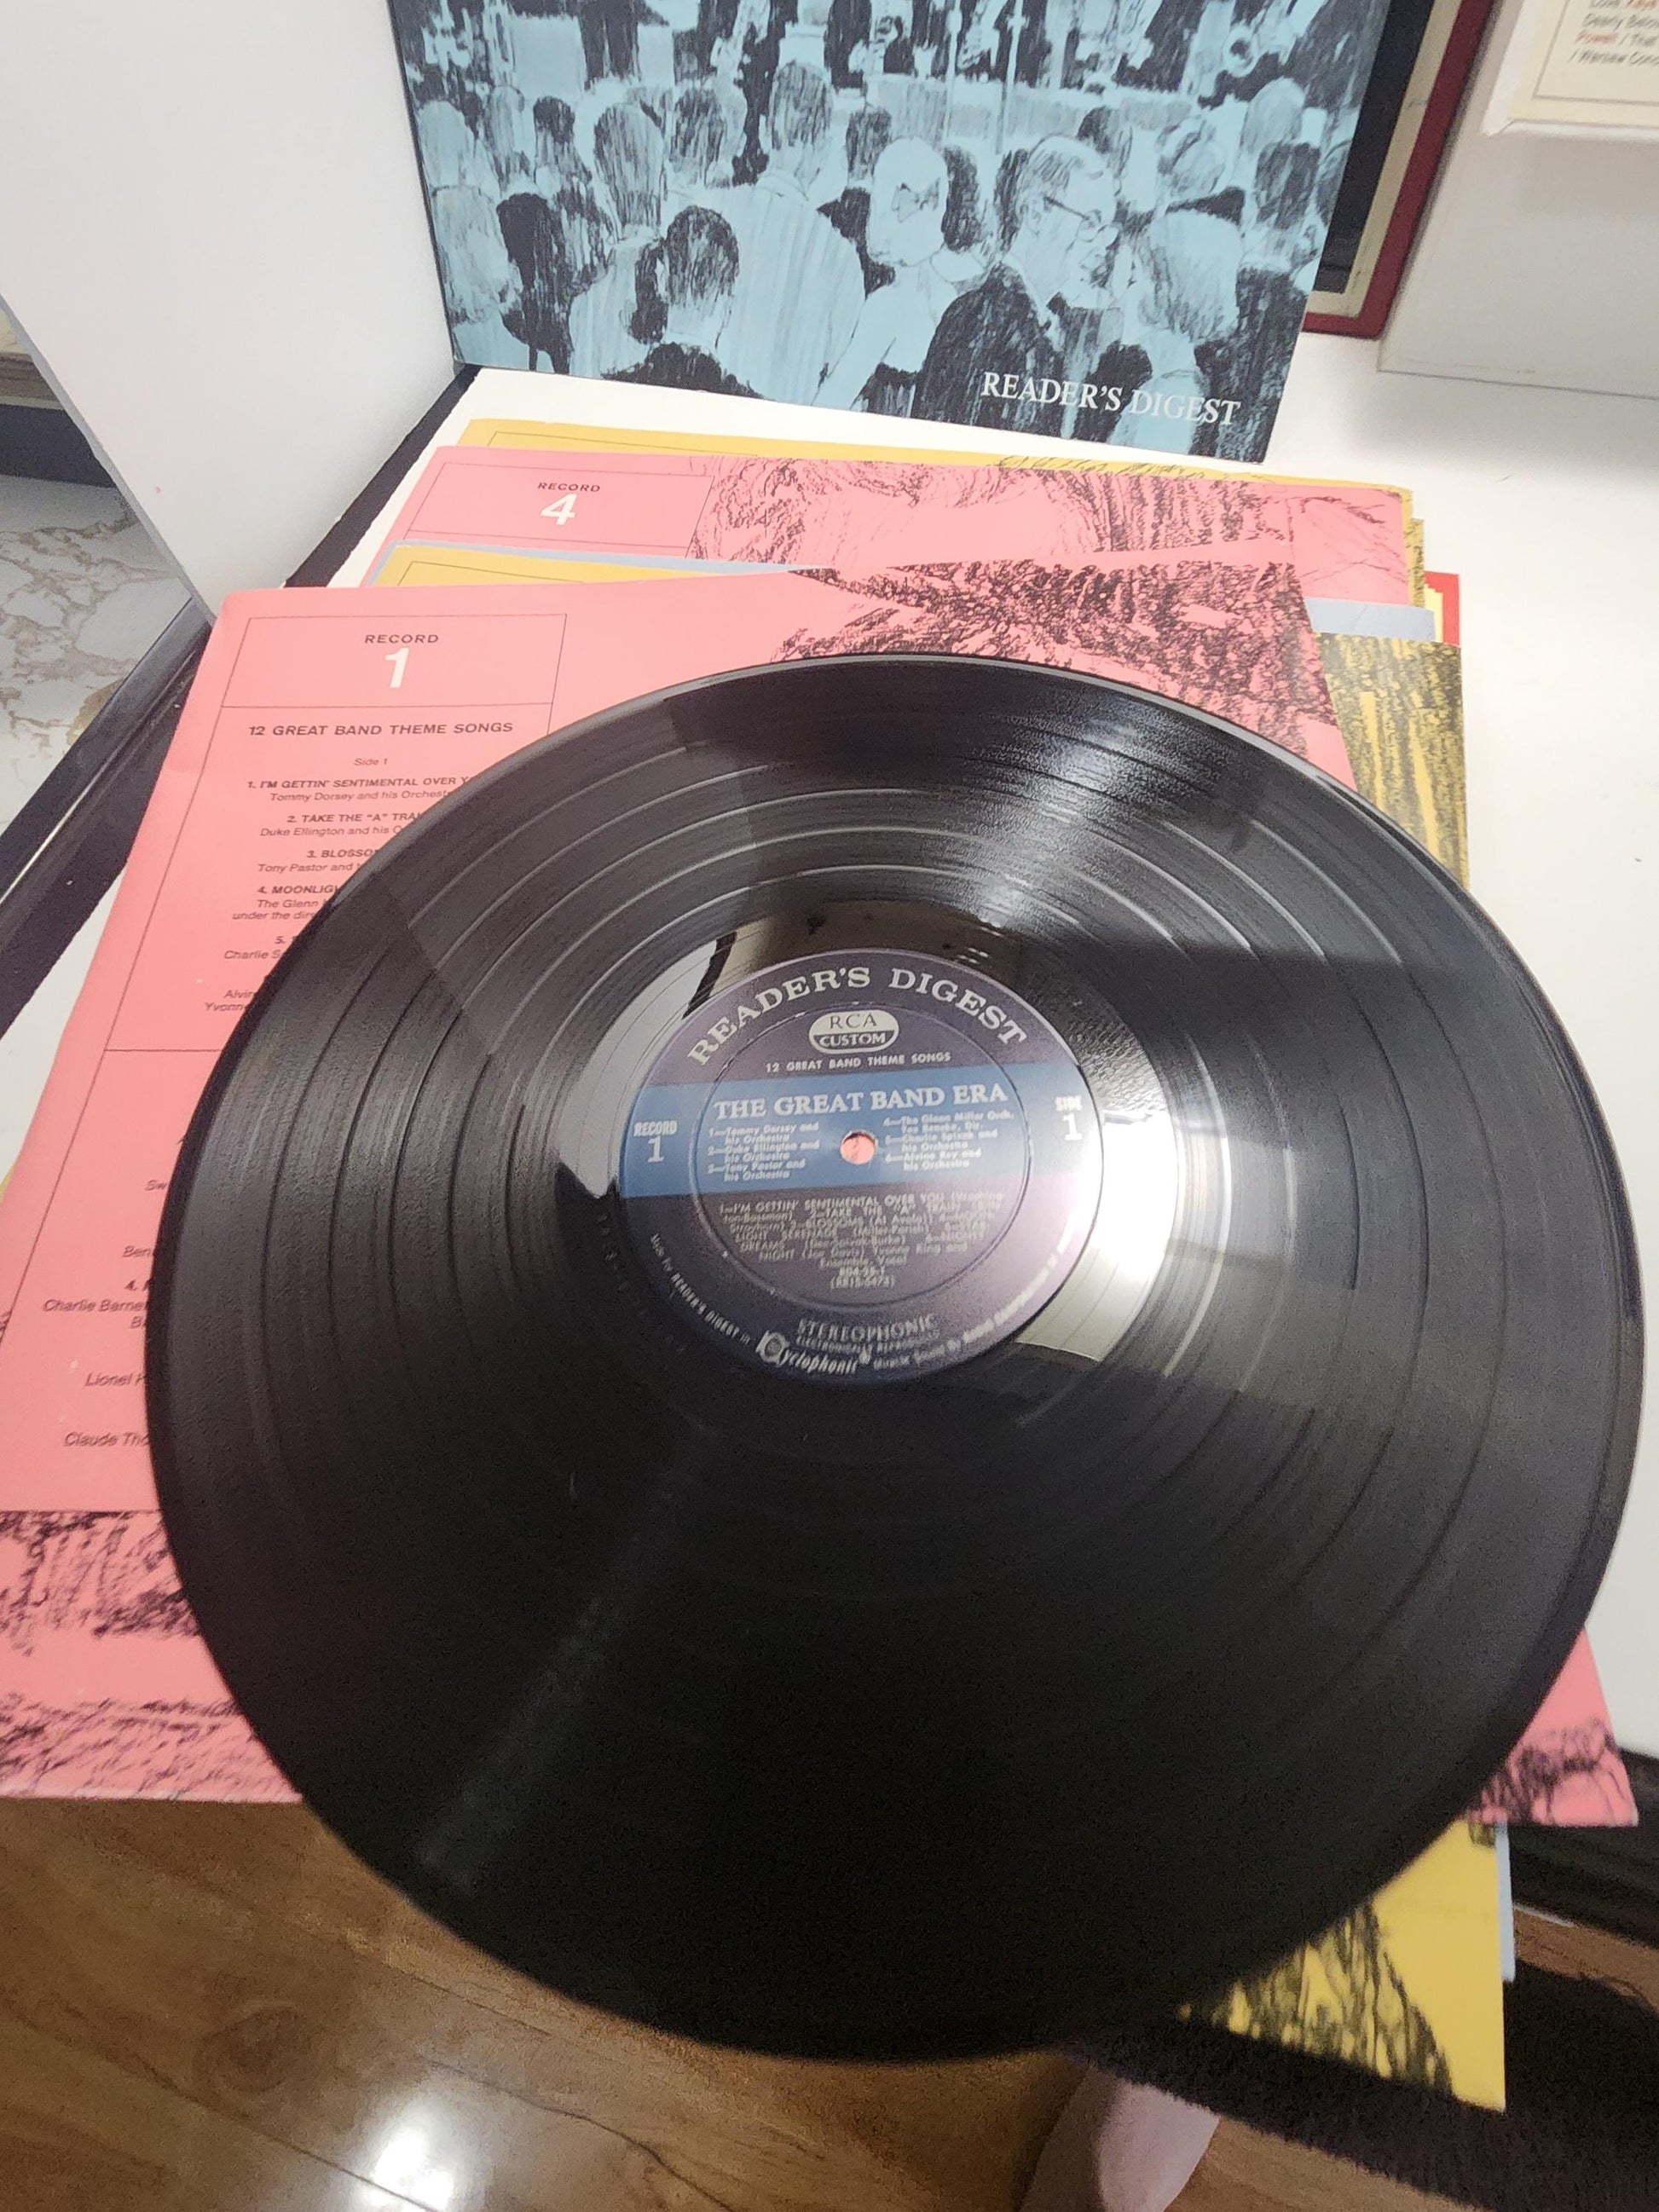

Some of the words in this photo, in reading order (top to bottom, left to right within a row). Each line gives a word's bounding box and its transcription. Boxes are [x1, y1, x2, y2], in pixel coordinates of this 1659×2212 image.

[980, 372, 1123, 411] READER'S
[1128, 389, 1240, 425] DIGEST
[537, 482, 601, 493] RECORD
[540, 493, 577, 525] 4
[364, 633, 439, 644] RECORD
[384, 646, 410, 688] 1
[248, 725, 265, 736] 12
[272, 725, 328, 736] GREAT
[334, 725, 382, 735] BAND
[390, 724, 447, 735] THEME
[453, 722, 513, 734] SONGS
[354, 757, 379, 766] Side
[383, 757, 389, 766] 1
[259, 780, 277, 789] I'M
[332, 777, 419, 788] SENTIMENTAL
[422, 777, 457, 786] OVER
[269, 792, 310, 803] Tommy
[314, 791, 354, 802] Dorsey
[356, 791, 380, 800] and
[381, 791, 399, 800] his
[302, 814, 335, 823] TAKE
[338, 813, 362, 823] THE
[259, 828, 291, 838] Duke
[292, 827, 345, 838] Ellington
[347, 826, 370, 835] and
[372, 825, 390, 835] his
[258, 863, 286, 874] Tony
[289, 863, 328, 872] Pastor
[330, 862, 354, 872] and
[257, 899, 280, 909] The
[282, 898, 319, 909] Glenn
[232, 911, 269, 921] under
[270, 911, 291, 920] the
[223, 950, 269, 960] Charlie
[686, 966, 870, 1066] READER'S
[889, 967, 1026, 1047] DIGEST
[829, 1013, 877, 1029] RCA
[818, 1031, 887, 1048] CUSTOM
[766, 1063, 780, 1074] 12
[786, 1060, 823, 1071] GREAT
[828, 1058, 862, 1069] BAND
[866, 1054, 905, 1066] THEME
[910, 1051, 951, 1064] SONGS
[714, 1098, 767, 1120] THE
[773, 1092, 864, 1116] GREAT
[870, 1086, 945, 1111] BAND
[952, 1083, 1009, 1106] ERA
[921, 1113, 951, 1124] Glenn
[954, 1111, 984, 1122] Miller
[633, 1119, 679, 1137] RECORD
[763, 1123, 797, 1135] Dorsey
[799, 1121, 820, 1133] and
[1062, 1112, 1084, 1141] 1
[743, 1133, 791, 1145] Orchestra
[978, 1128, 999, 1140] and
[647, 1135, 665, 1164] 1
[800, 1139, 821, 1151] and
[921, 1140, 968, 1152] Orchestra
[743, 1151, 791, 1164] Orchestra
[961, 1147, 982, 1159] and
[785, 1158, 806, 1170] and
[922, 1158, 971, 1170] Orchestra
[743, 1170, 791, 1181] Orchestra
[804, 1195, 880, 1211] SENTIMENTAL
[884, 1193, 916, 1207] OVER
[43, 1298, 96, 1313] Charlie
[98, 1299, 145, 1313] Barne
[703, 1309, 741, 1339] DIGEST
[84, 1372, 133, 1387] Lionel
[64, 1430, 118, 1447] Claude
